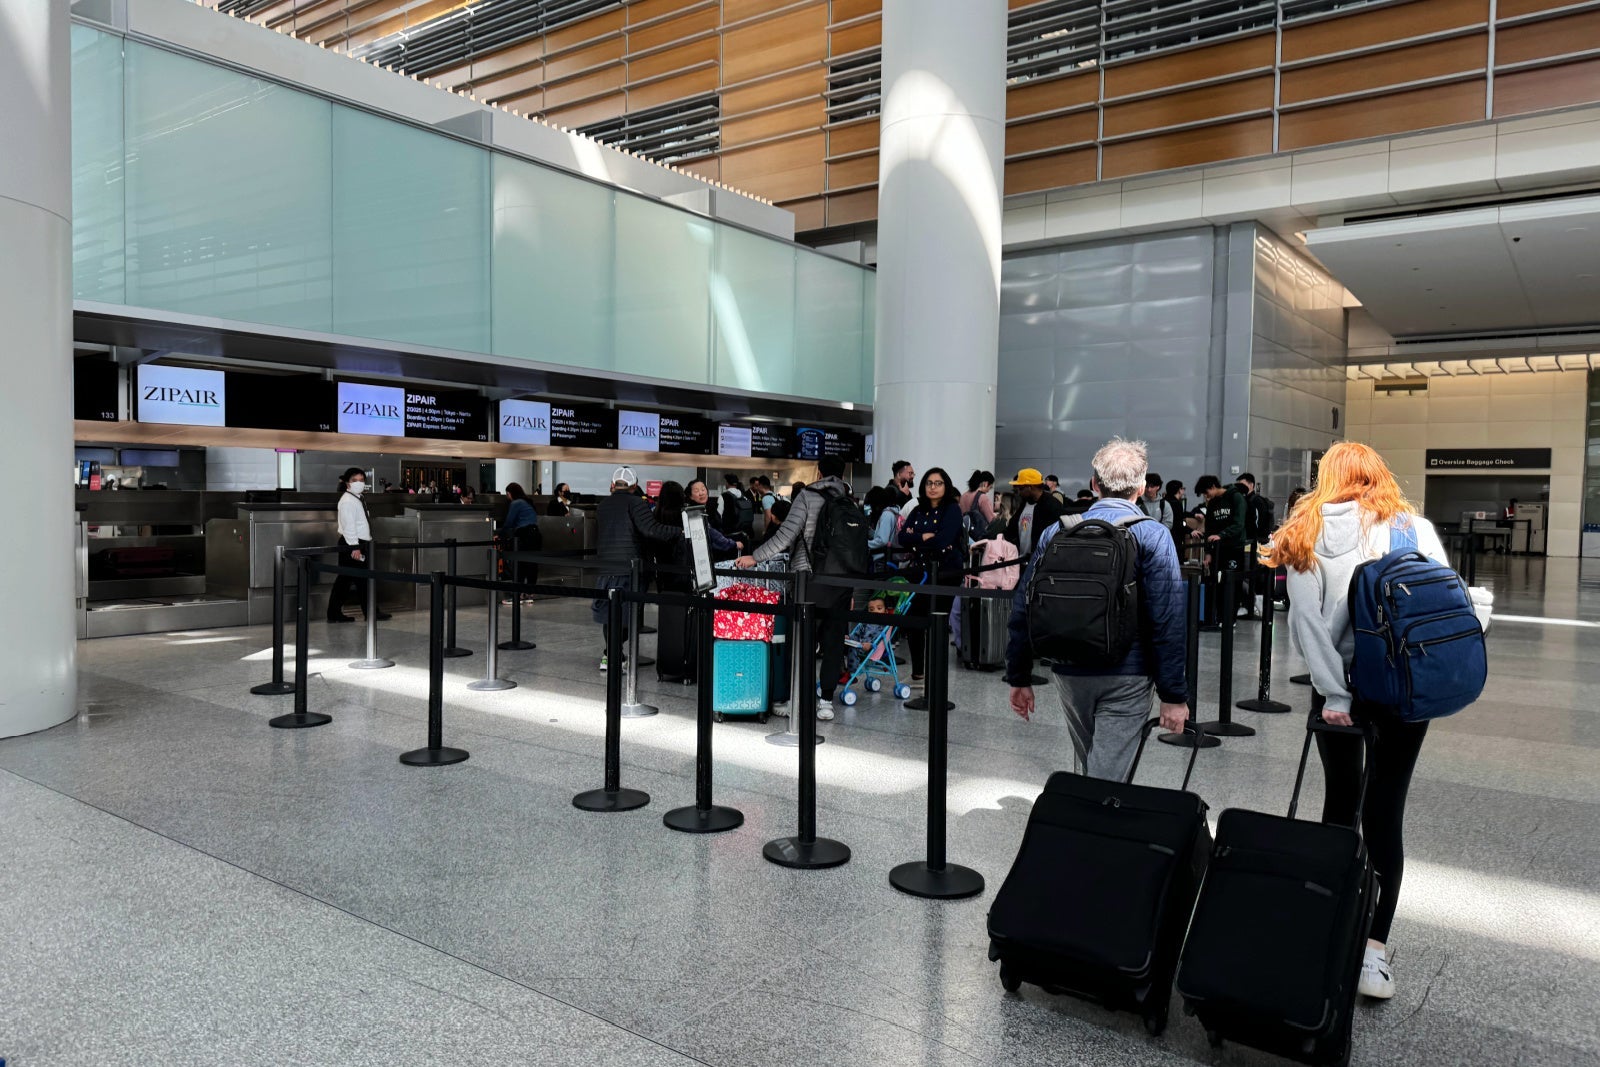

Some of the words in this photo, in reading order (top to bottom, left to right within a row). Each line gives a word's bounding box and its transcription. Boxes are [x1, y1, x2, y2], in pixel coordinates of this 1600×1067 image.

[144, 386, 219, 405] ZIPAIR
[406, 394, 437, 406] ZIPAIR
[342, 401, 400, 418] ZIPAIR
[552, 407, 575, 418] ZIPAIR
[406, 413, 427, 422] Boarding
[503, 415, 547, 430] ZIPAIR
[660, 418, 680, 427] ZIPAIR
[621, 425, 657, 438] ZIPAIR
